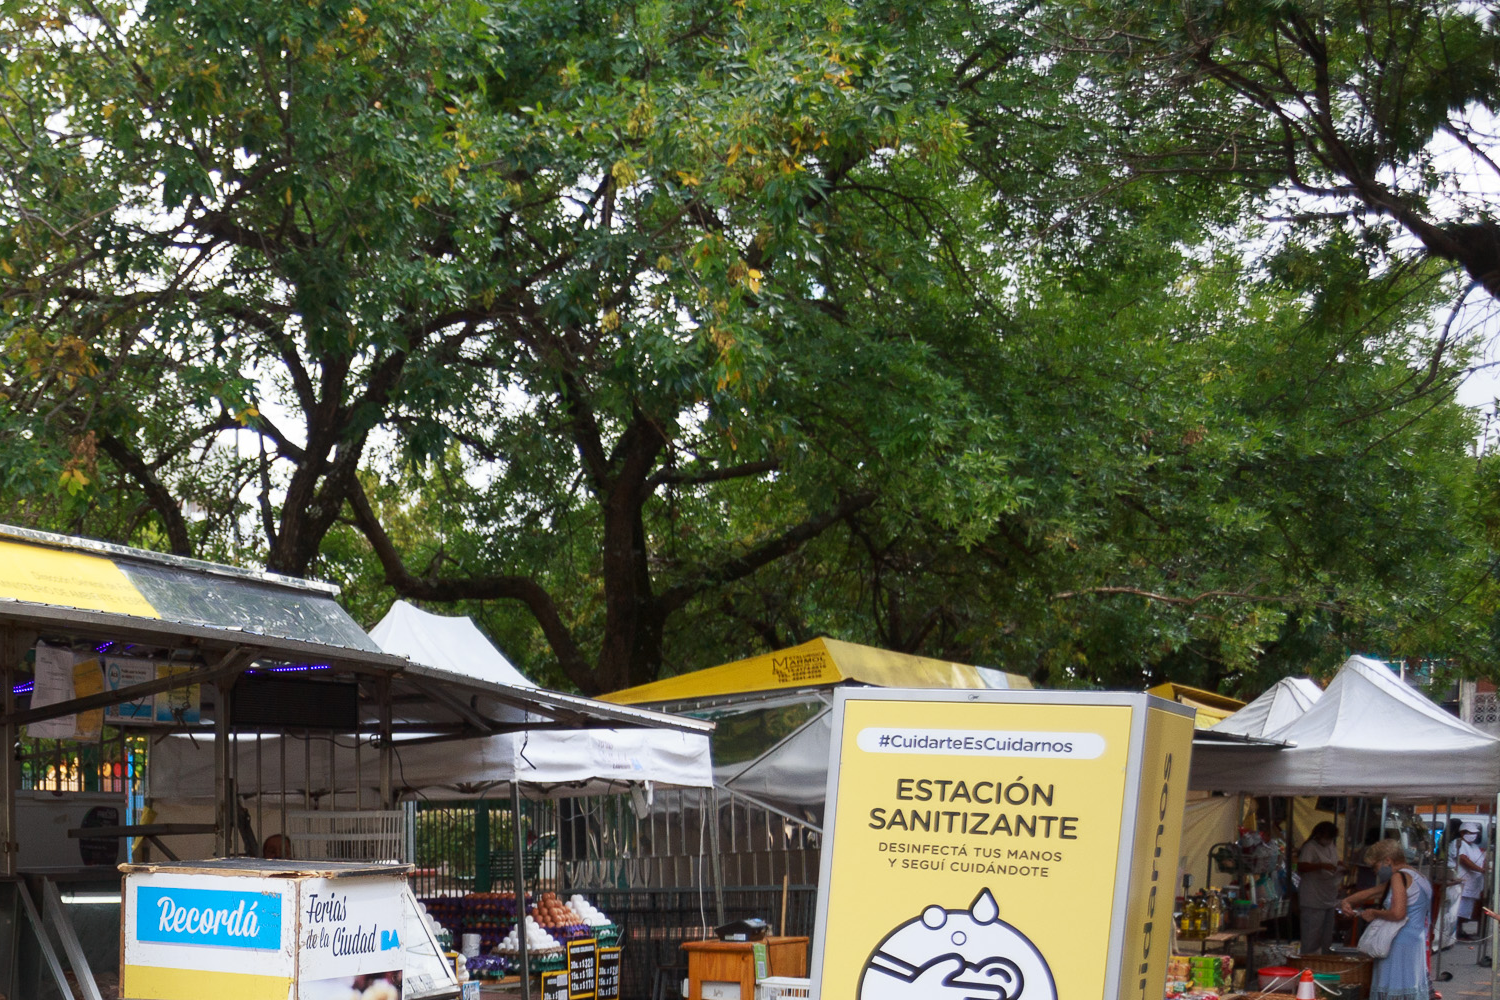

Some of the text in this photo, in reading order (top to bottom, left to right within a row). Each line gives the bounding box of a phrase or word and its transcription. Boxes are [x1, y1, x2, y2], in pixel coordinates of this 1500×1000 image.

[878, 734, 1074, 754] #CuidarteEsCuidarnos
[895, 775, 1055, 807] ESTACIÓN
[868, 807, 1079, 840] SANITIZANTE
[878, 842, 1063, 862] DESINFECTÁ TUS MANOS
[888, 858, 1050, 878] Y SEGUÍ CUIDÁNDOTE
[156, 895, 261, 938] Recordá
[305, 892, 348, 924] Ferias
[305, 923, 401, 957] de la Ciudad BA
